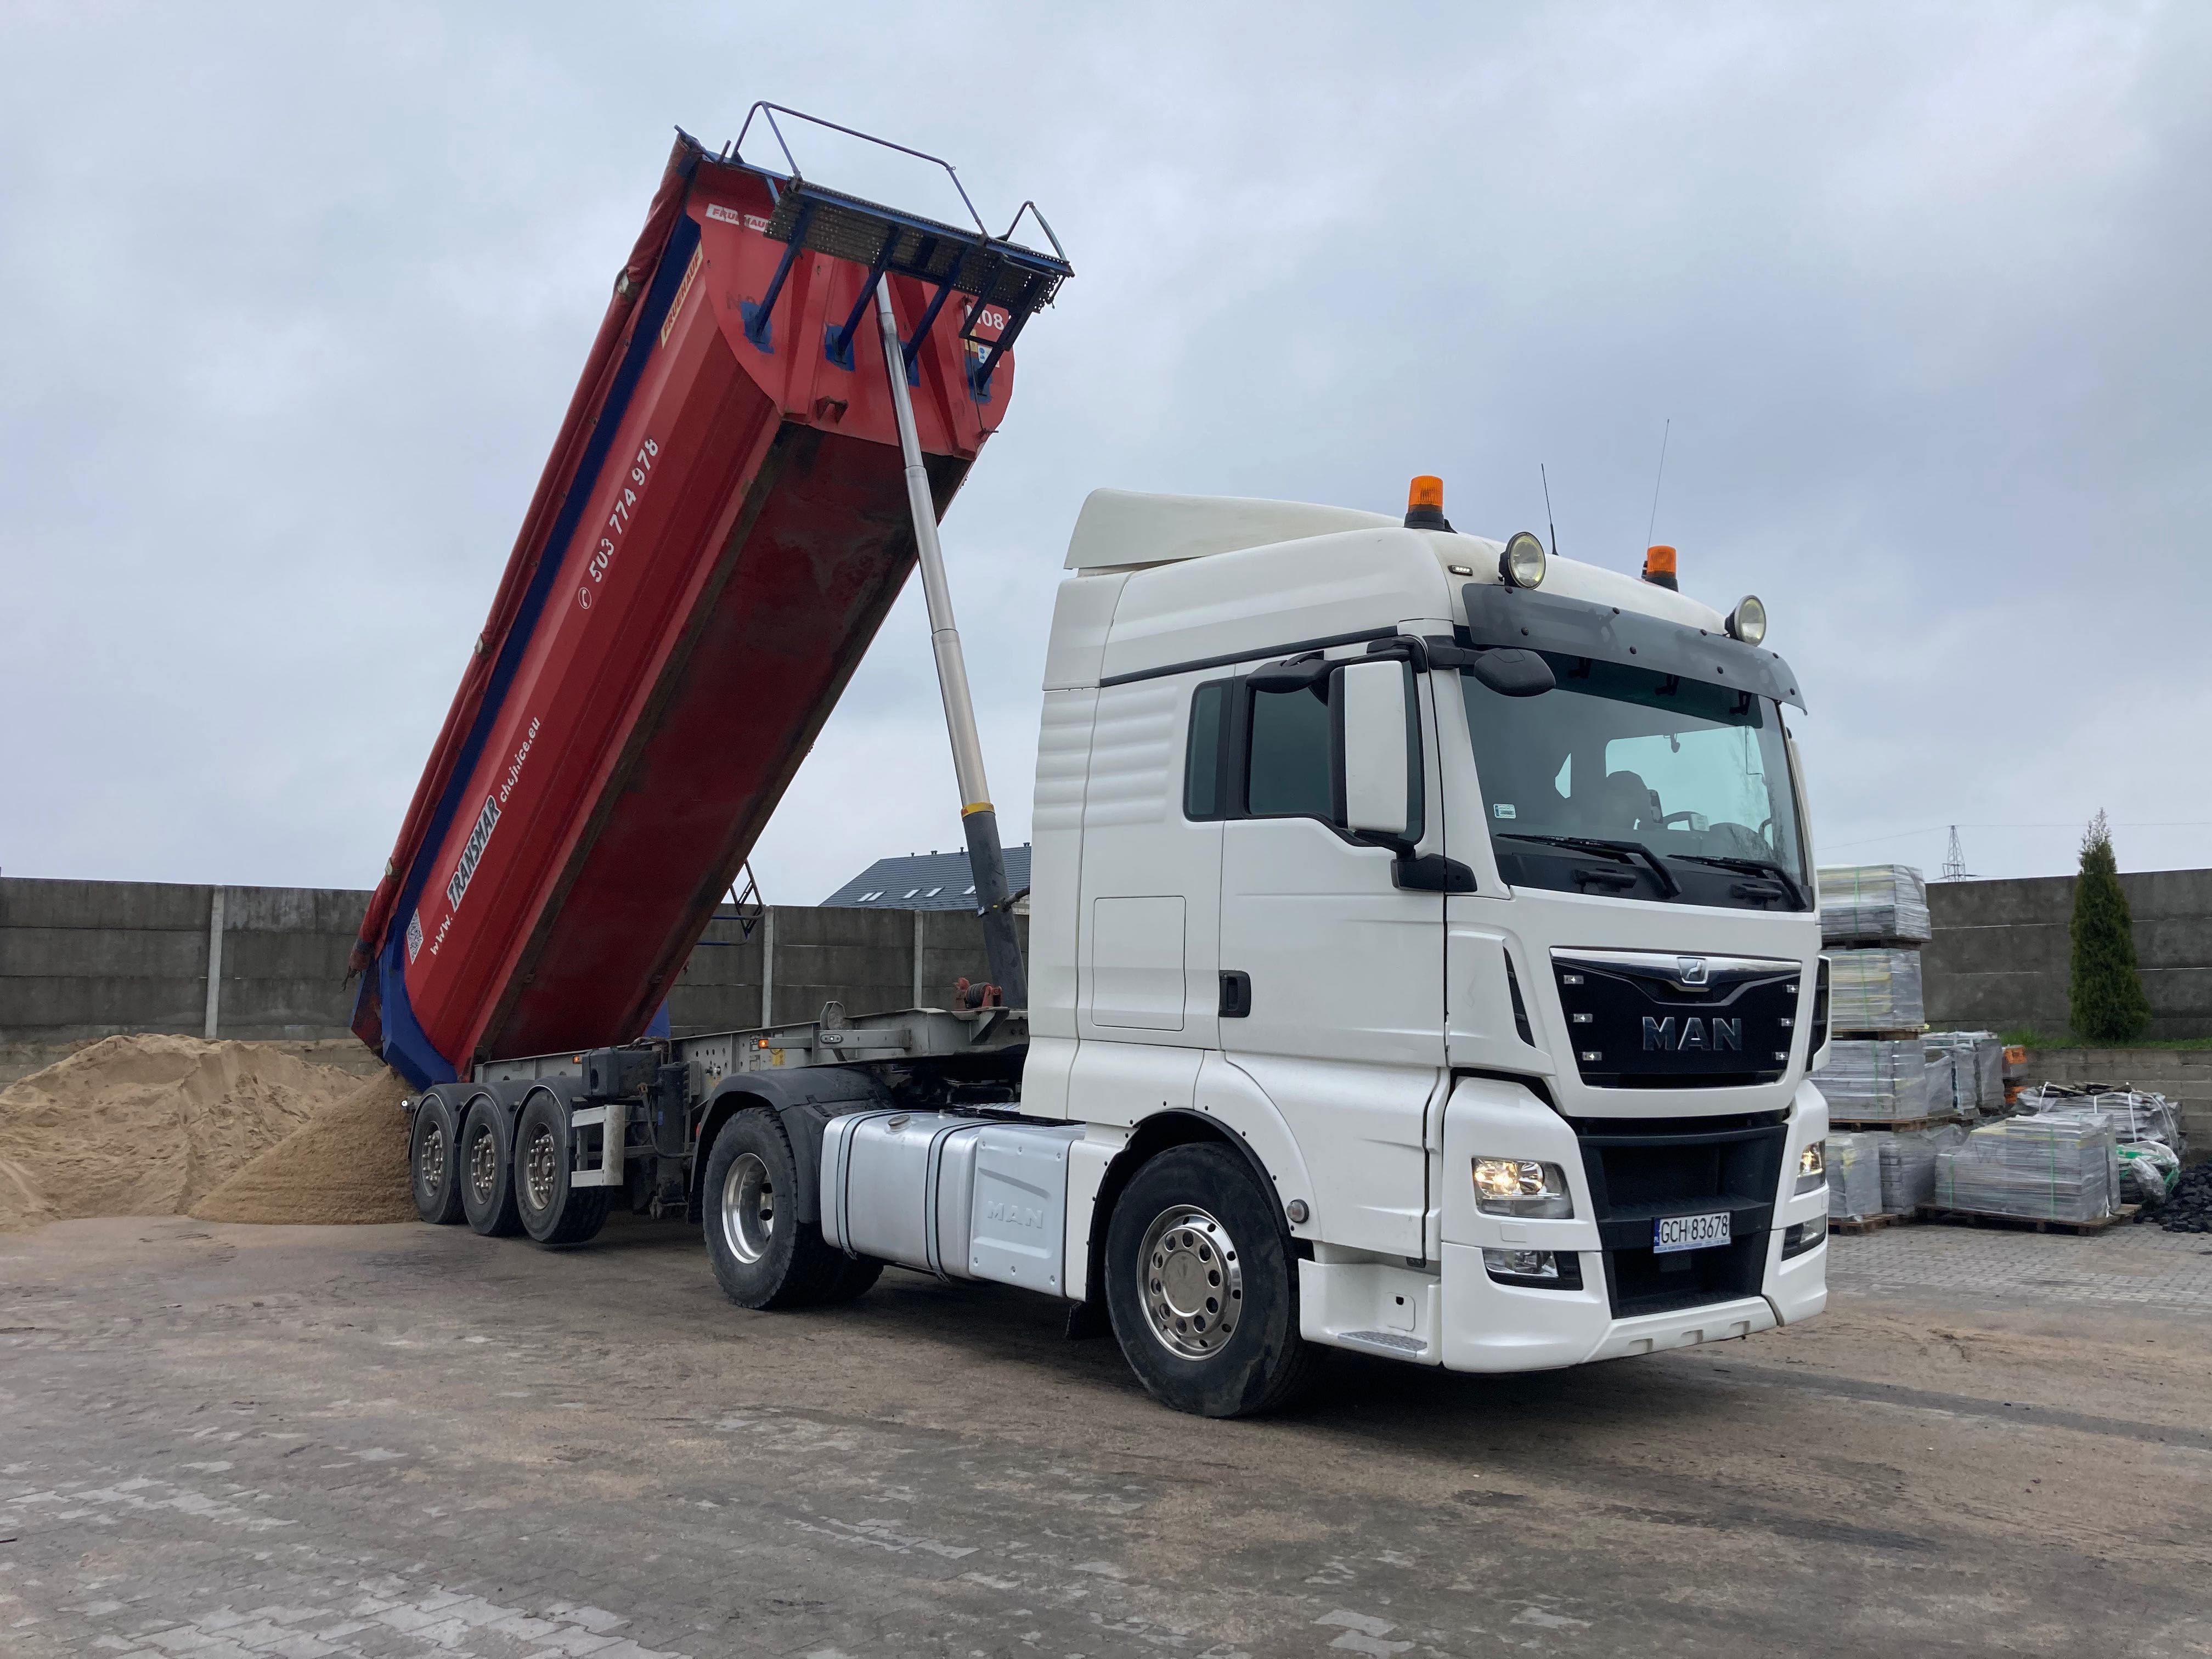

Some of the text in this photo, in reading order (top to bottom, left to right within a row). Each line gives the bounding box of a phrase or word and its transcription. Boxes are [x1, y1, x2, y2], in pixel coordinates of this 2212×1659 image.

[663, 252, 699, 338] FRUEHAUF
[609, 488, 637, 536] 774
[631, 438, 658, 486] 978
[447, 795, 501, 912] TRANSMAR
[1642, 1016, 1742, 1051] MAN
[987, 1200, 1043, 1229] MAN
[1661, 1215, 1729, 1244] GCH 83678
